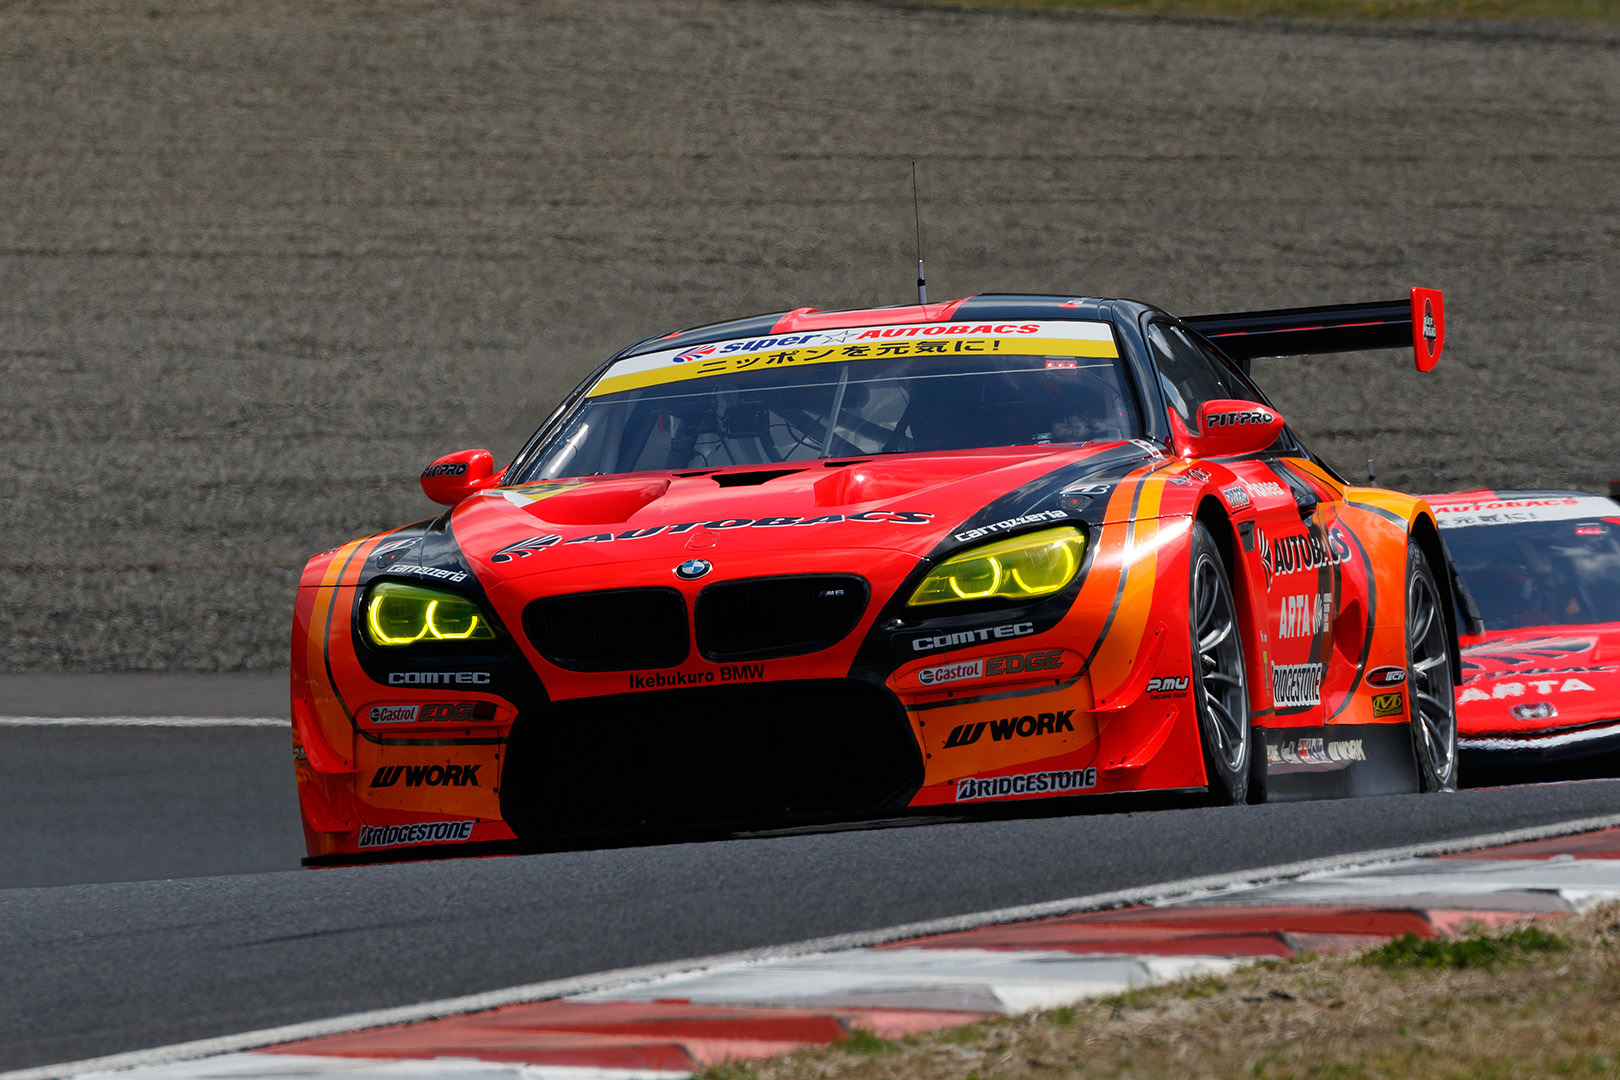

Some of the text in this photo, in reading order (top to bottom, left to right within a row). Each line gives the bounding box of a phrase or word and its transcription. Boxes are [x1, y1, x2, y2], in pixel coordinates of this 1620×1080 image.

[855, 324, 1040, 340] AUTOBACS
[1435, 498, 1580, 514] AUTOBACS
[562, 511, 935, 546] AUTOBACS
[954, 509, 1068, 543] carrozzeria
[1274, 527, 1352, 576] AUTOBACS
[386, 564, 468, 583] carrozzeria
[1279, 594, 1310, 639] ARTA
[912, 622, 1034, 651] COMTEC
[389, 672, 490, 684] COMTEC
[629, 664, 765, 689] Ikebukuro BMW
[934, 650, 1065, 682] Castrol EDGE
[1272, 662, 1322, 706] RIDGESTONE
[1457, 678, 1596, 706] ARTA
[380, 703, 484, 722] Castrol EDG
[956, 767, 1097, 801] BRIDGESTONE
[358, 820, 476, 848] BRIDGESTONE
